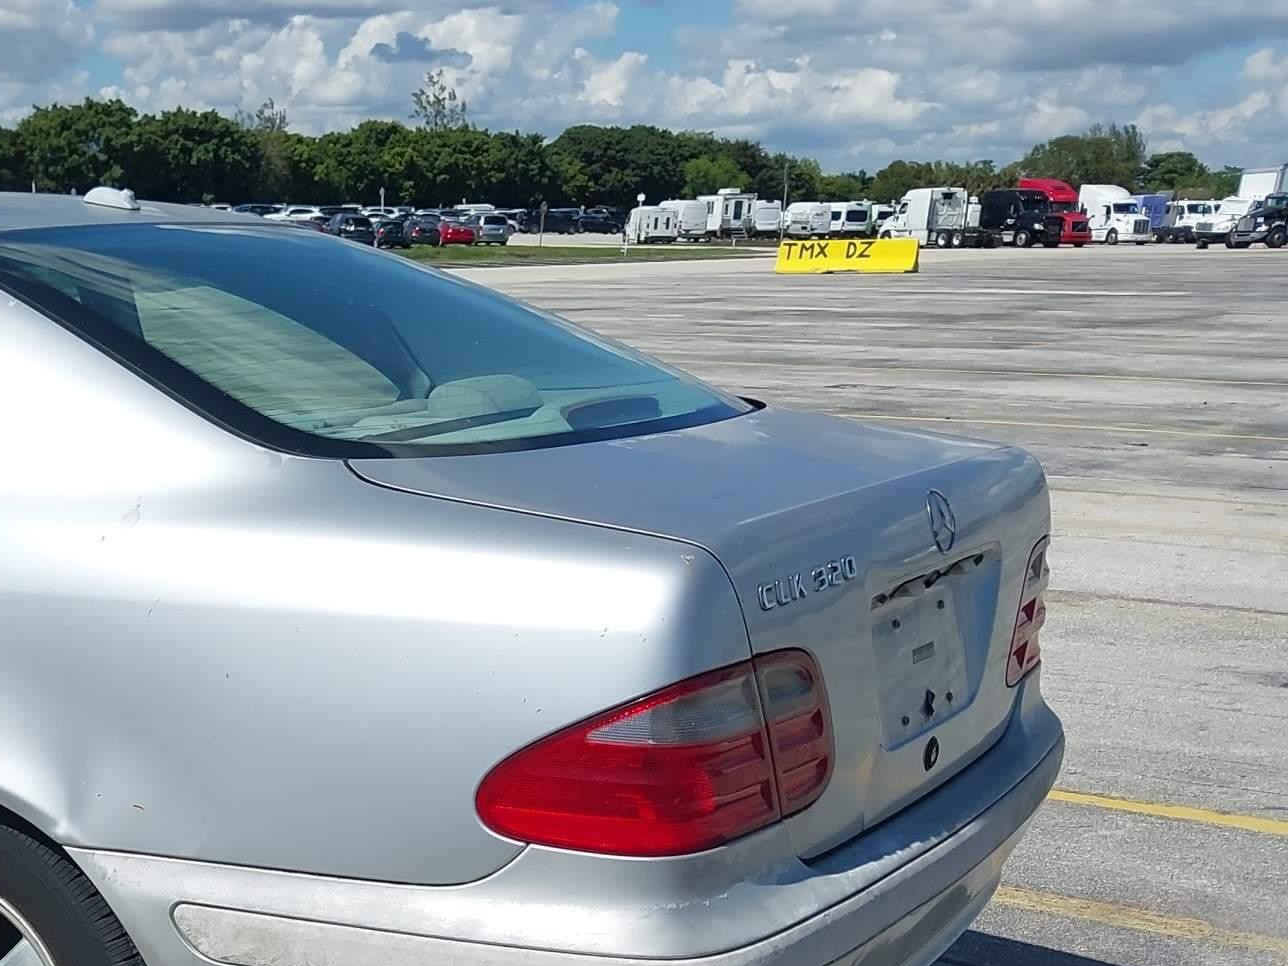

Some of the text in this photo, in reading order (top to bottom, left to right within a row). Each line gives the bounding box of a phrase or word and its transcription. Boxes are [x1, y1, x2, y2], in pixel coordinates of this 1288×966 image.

[782, 241, 877, 260] TMX DZ
[758, 556, 857, 611] CLK 320
